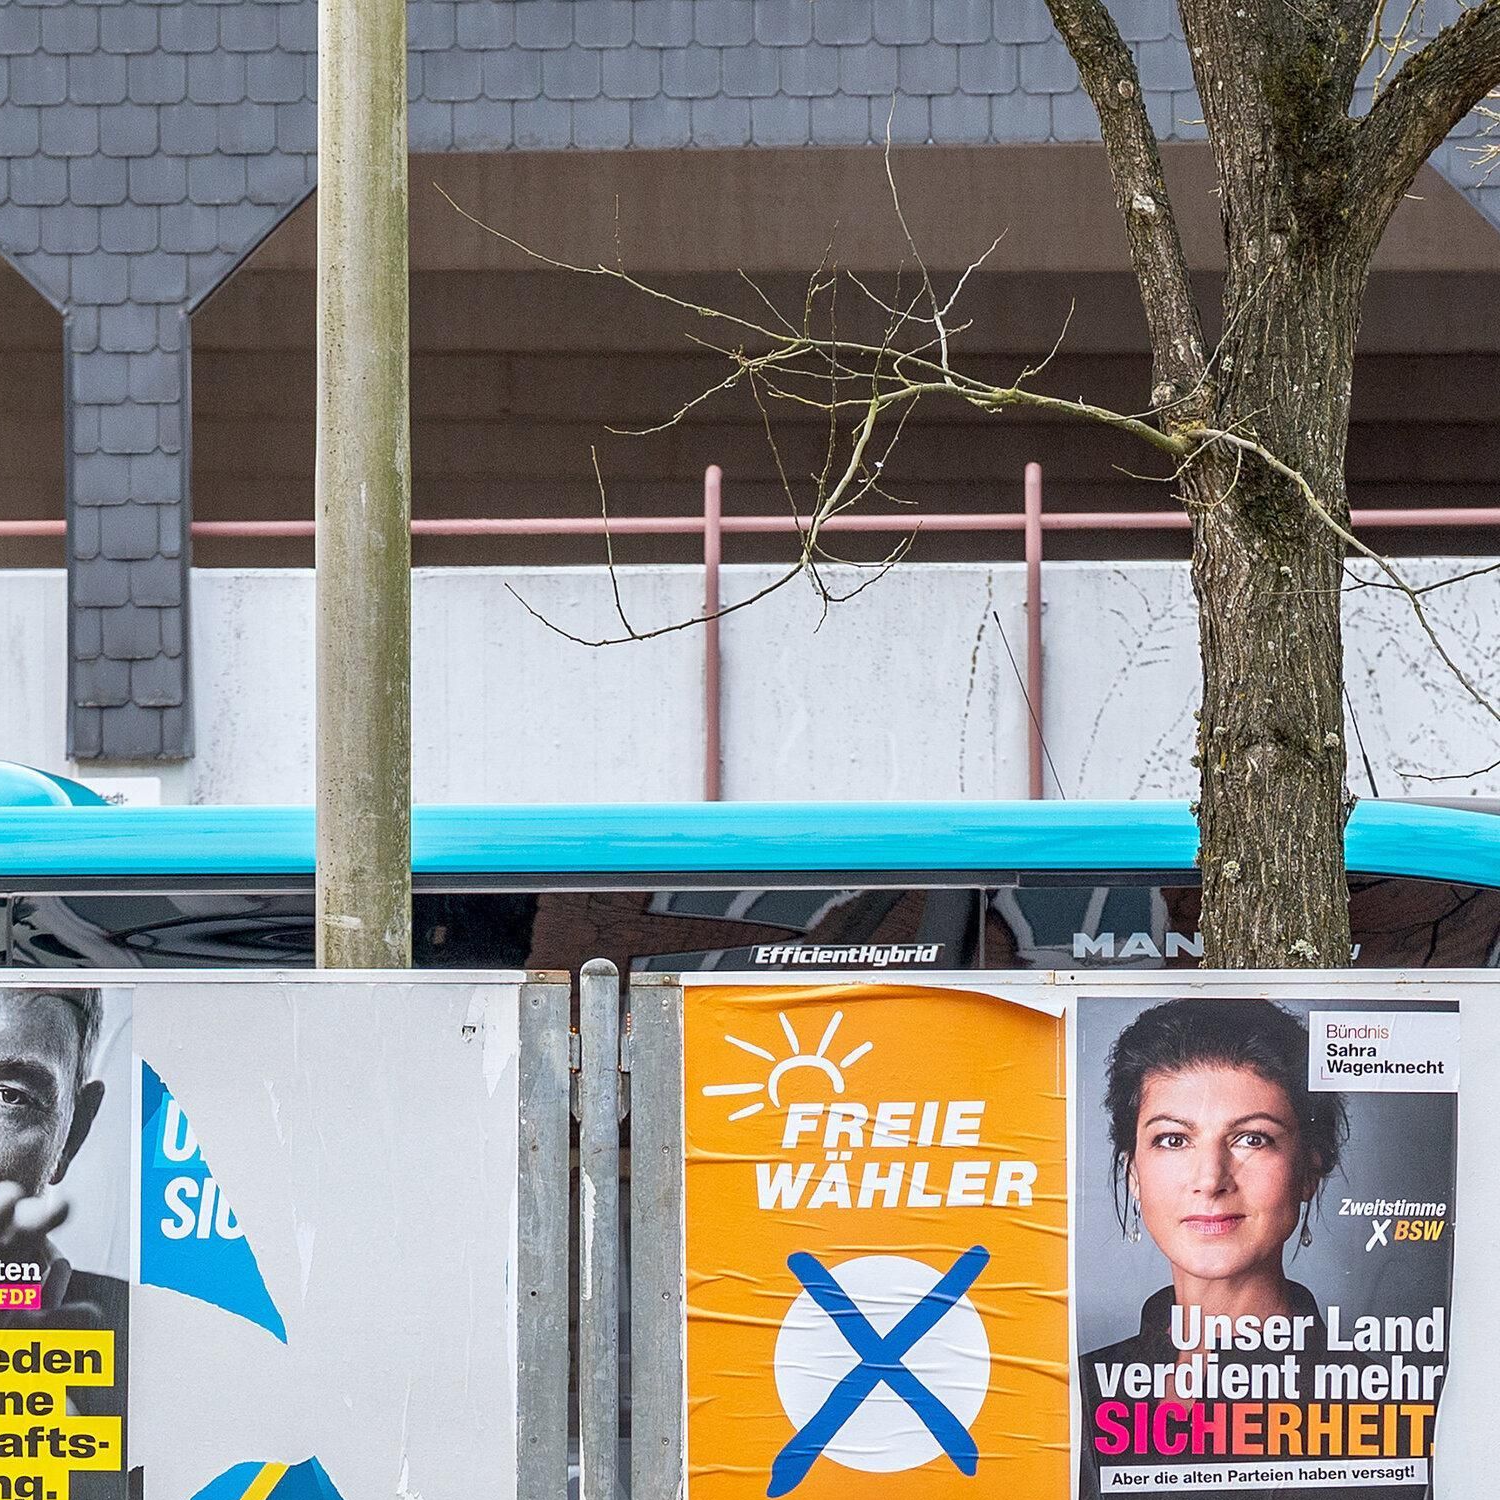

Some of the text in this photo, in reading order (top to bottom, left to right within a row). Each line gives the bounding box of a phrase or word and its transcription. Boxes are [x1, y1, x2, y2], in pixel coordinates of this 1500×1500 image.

[755, 944, 938, 967] EfficientHybrid
[1073, 932, 1204, 958] MAN
[1326, 1024, 1390, 1039] Bündnis
[1326, 1043, 1377, 1058] Sahra
[1327, 1060, 1445, 1076] Wagenknecht
[781, 1101, 986, 1149] FREIE
[756, 1151, 1038, 1209] WÄHLER
[1339, 1199, 1446, 1217] Zweitstimme
[1394, 1221, 1443, 1241] BSW
[1171, 1305, 1444, 1352] Unser Land
[1095, 1354, 1444, 1400] verdient mehr
[1112, 1465, 1415, 1485] Aber die alten Parteien haben versagt!
